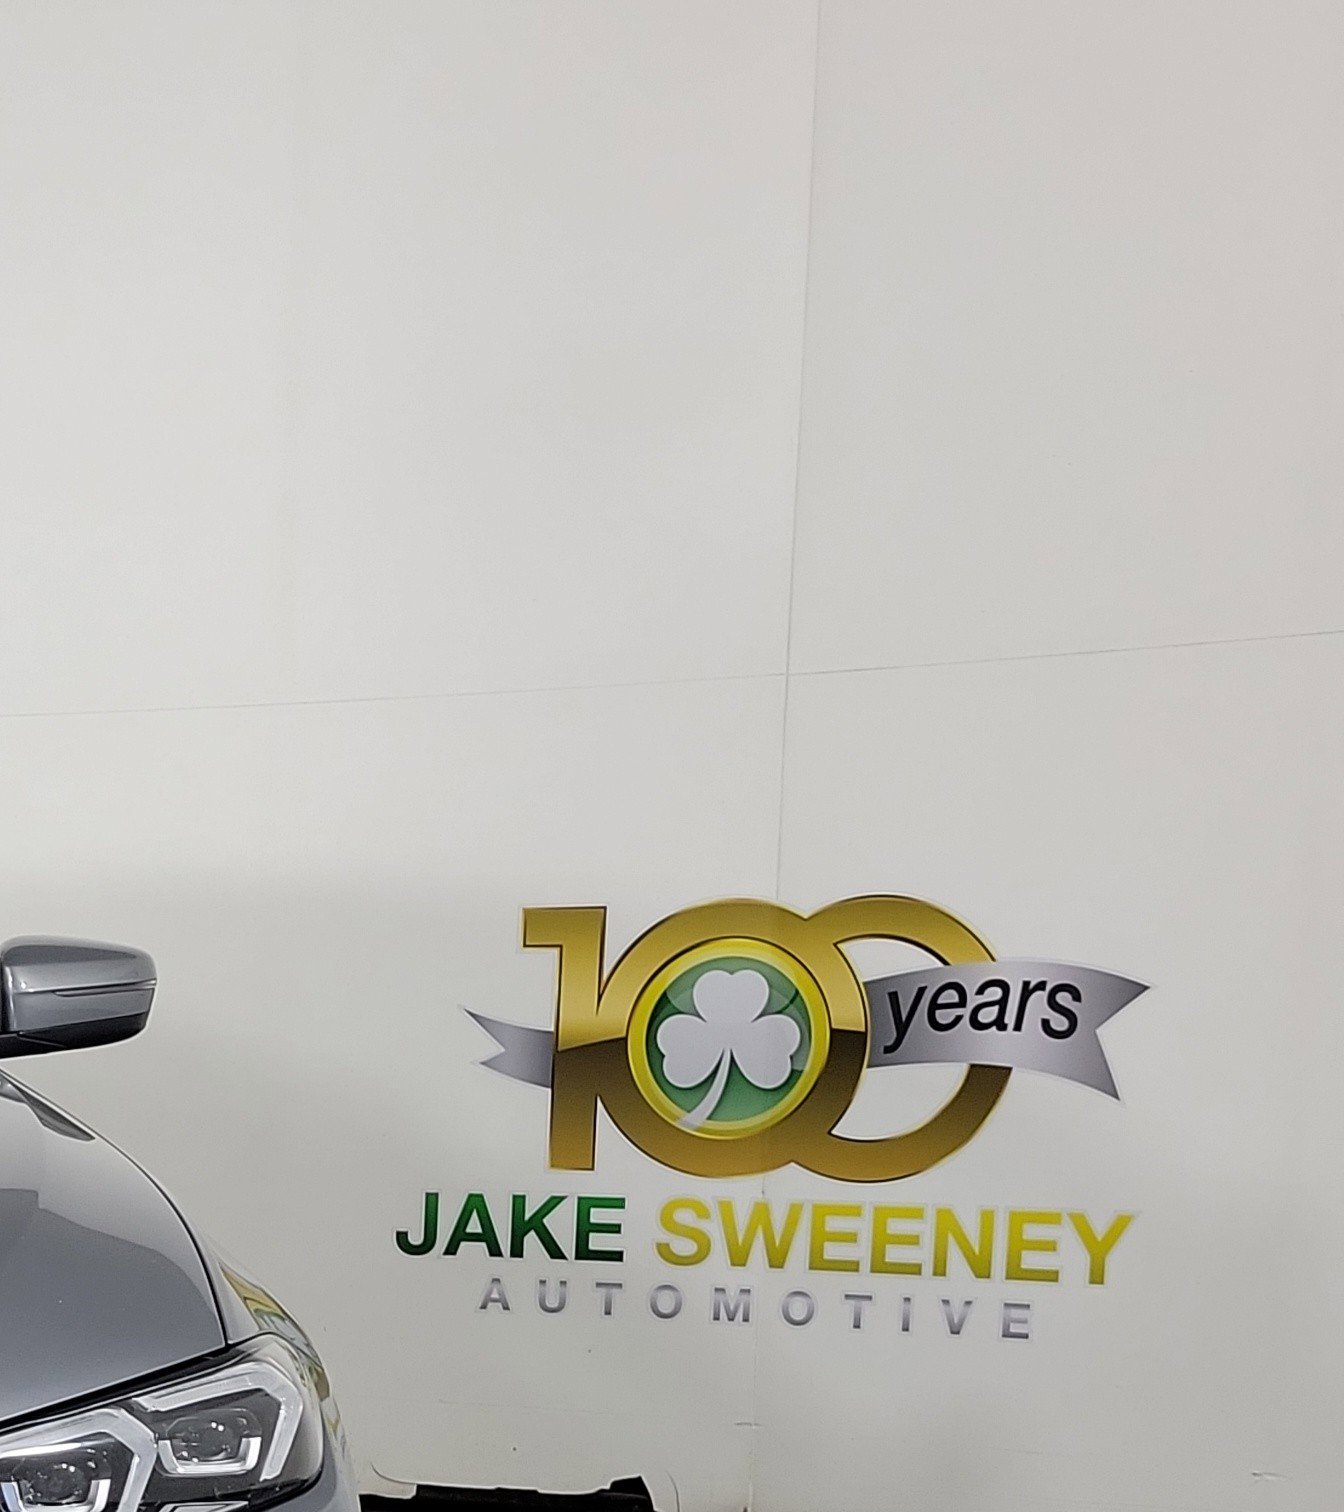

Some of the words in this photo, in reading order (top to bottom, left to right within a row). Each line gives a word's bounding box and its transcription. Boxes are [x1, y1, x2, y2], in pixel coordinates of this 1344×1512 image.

[522, 894, 1012, 1183] 100
[883, 977, 1082, 1055] years
[394, 1192, 626, 1262] JAKE
[655, 1196, 1136, 1286] SWEENEY
[479, 1277, 1031, 1340] AUTOMOTIVE
